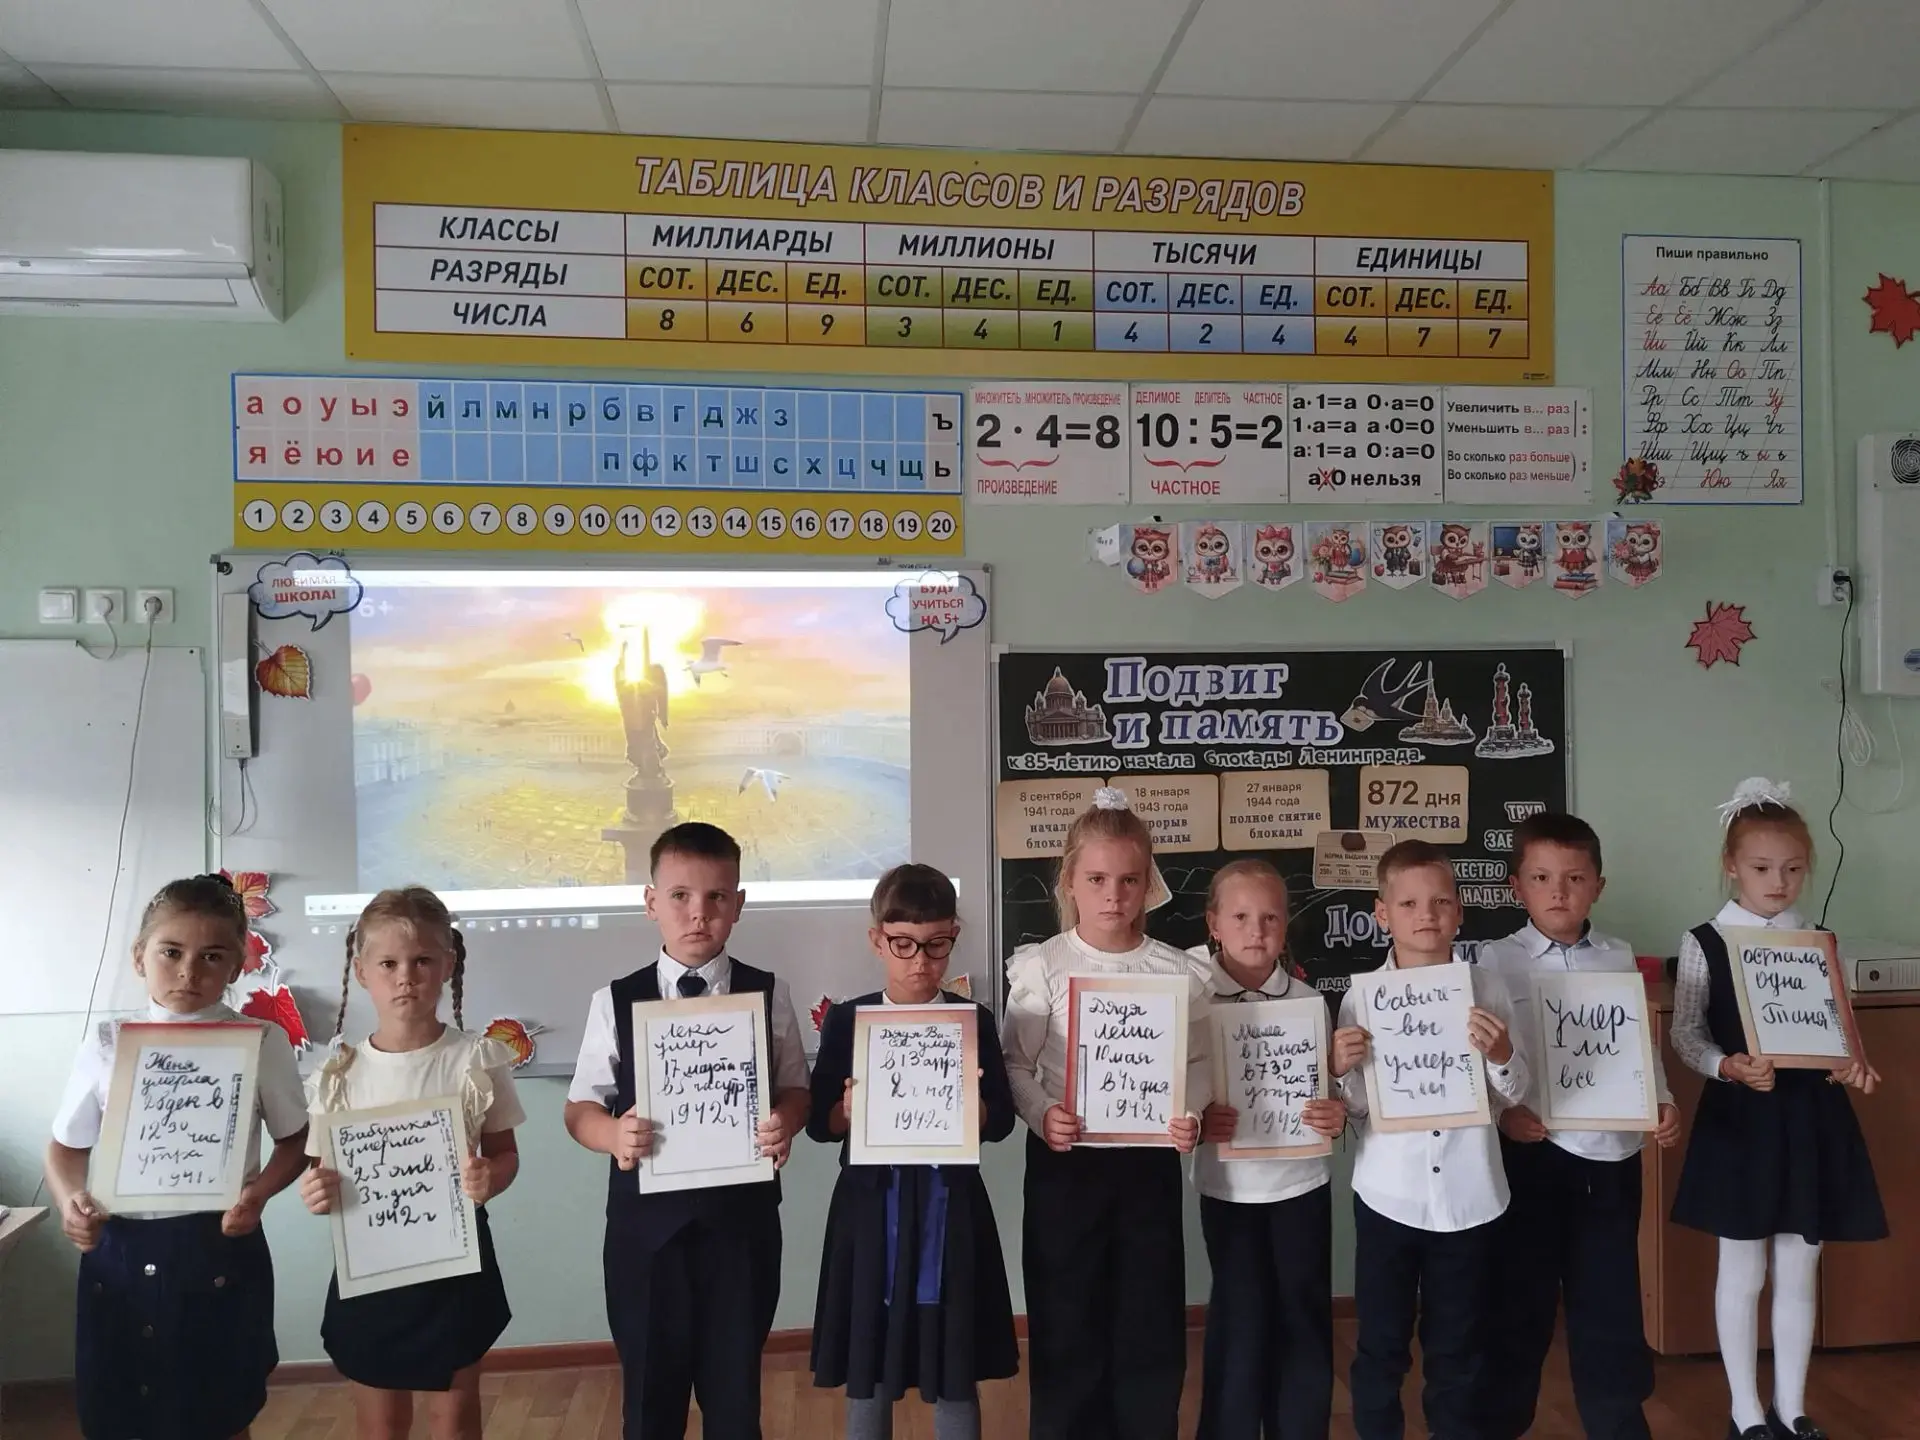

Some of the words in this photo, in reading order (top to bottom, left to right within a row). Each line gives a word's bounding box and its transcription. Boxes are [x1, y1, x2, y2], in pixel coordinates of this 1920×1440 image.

[635, 156, 837, 207] ТАБЛИЦА
[849, 167, 1044, 210] КЛАССОВ
[1054, 174, 1085, 211] И
[1092, 176, 1305, 221] РАЗРЯДОВ
[439, 215, 559, 243] КЛАССЫ
[652, 226, 832, 256] МИЛЛИАРДЫ
[899, 234, 1055, 261] МИЛЛИОНЫ
[1153, 241, 1257, 266] ТЫСЯЧИ
[1356, 247, 1482, 274] ЕДИНИЦЫ
[1656, 247, 1693, 260] Пиши
[1697, 249, 1769, 261] правильно
[430, 259, 567, 288] РАЗРЯДЫ
[639, 266, 695, 291] СОТ.
[717, 268, 779, 296] ДЕС.
[805, 271, 848, 298] ЕД.
[877, 273, 930, 298] СОТ.
[952, 275, 1012, 304] ДЕС.
[1036, 279, 1077, 305] ЕД.
[1106, 280, 1156, 305] СОТ.
[1177, 282, 1235, 308] ДЕС.
[1260, 284, 1299, 310] ЕД.
[1326, 285, 1375, 309] СОТ.
[1395, 286, 1452, 312] ДЕС.
[1475, 288, 1513, 313] ЕД.
[452, 302, 548, 328] ЧИСЛА
[660, 308, 676, 331] 8
[740, 311, 755, 334] 6
[820, 313, 835, 336] 9
[898, 316, 913, 338] 3
[973, 318, 988, 340] 4
[1051, 320, 1063, 342] 1
[1124, 322, 1139, 343] 4
[1198, 323, 1213, 345] 2
[1271, 324, 1286, 346] 4
[1344, 325, 1358, 347] 4
[1417, 326, 1430, 348] 7
[1489, 327, 1502, 348] 7
[975, 392, 1022, 405] МНОЖИТЕЛЬ
[1025, 392, 1071, 405] МНОЖИТЕЛЬ
[1072, 392, 1121, 406] ПРОИЗВЕДЕНИЕ
[1136, 391, 1181, 405] ДЕЛИМОЕ
[1194, 392, 1231, 405] ДЕЛИТЕЛЬ
[1243, 392, 1283, 405] ЧАСТНОЕ
[1447, 401, 1519, 416] Увеличить
[1547, 404, 1570, 418] раз
[1447, 422, 1519, 435] Уменьшить
[1547, 424, 1570, 437] раз
[1447, 450, 1461, 462] Во
[1464, 452, 1506, 464] сколько
[1509, 454, 1527, 466] раз
[1530, 450, 1571, 464] больше
[1351, 472, 1421, 487] нельзя
[1448, 469, 1461, 481] Во
[1464, 471, 1506, 482] сколько
[1509, 472, 1527, 483] раз
[1530, 471, 1571, 482] меньше
[977, 479, 1058, 497] ПРОИЗВЕДЕНИЕ
[1151, 480, 1220, 496] ЧАСТНОЕ
[254, 510, 263, 524] 1
[293, 509, 304, 524] 2
[331, 509, 342, 524] 3
[368, 510, 379, 525] 4
[406, 510, 417, 525] 5
[443, 511, 454, 526] 6
[481, 511, 492, 526] 7
[517, 512, 528, 527] 8
[554, 513, 565, 528] 9
[585, 513, 605, 528] 10
[621, 513, 640, 529] 11
[655, 514, 676, 529] 12
[692, 514, 713, 530] 13
[726, 515, 747, 530] 14
[761, 516, 781, 531] 15
[795, 516, 815, 531] 16
[830, 517, 850, 532] 17
[864, 517, 884, 532] 18
[898, 518, 918, 533] 19
[932, 518, 952, 533] 20
[272, 575, 337, 588] ЛЮБИМАЯ
[274, 589, 336, 603] ШКОЛА!
[912, 598, 964, 609] УЧИТЬСЯ
[360, 597, 393, 618] 6+
[921, 615, 940, 625] НА
[944, 613, 960, 624] 5+
[1104, 659, 1287, 703] Подвиг
[1116, 716, 1147, 744] и
[1161, 711, 1341, 742] память
[1009, 756, 1022, 769] к
[1023, 753, 1120, 770] 85-летию
[1124, 754, 1195, 769] начала
[1204, 750, 1292, 768] блокады
[1135, 787, 1147, 798] 18
[1150, 787, 1190, 798] января
[1246, 783, 1260, 794] 27
[1262, 782, 1302, 794] января
[1367, 780, 1419, 806] 872
[1425, 792, 1461, 808] дня
[1020, 792, 1027, 802] 8
[1030, 790, 1082, 803] сентября
[1246, 797, 1272, 808] 1944
[1275, 796, 1300, 807] года
[1023, 806, 1047, 817] 1941
[1050, 807, 1076, 817] года
[1134, 802, 1160, 813] 1943
[1163, 803, 1189, 813] года
[1147, 819, 1188, 830] рорыв
[1229, 813, 1274, 824] полное
[1278, 812, 1322, 822] снятие
[1365, 813, 1461, 831] мужества
[1152, 834, 1192, 844] окады
[1249, 828, 1303, 840] блокады
[1026, 838, 1064, 849] блока
[1452, 862, 1504, 878] ЖЕСТВО
